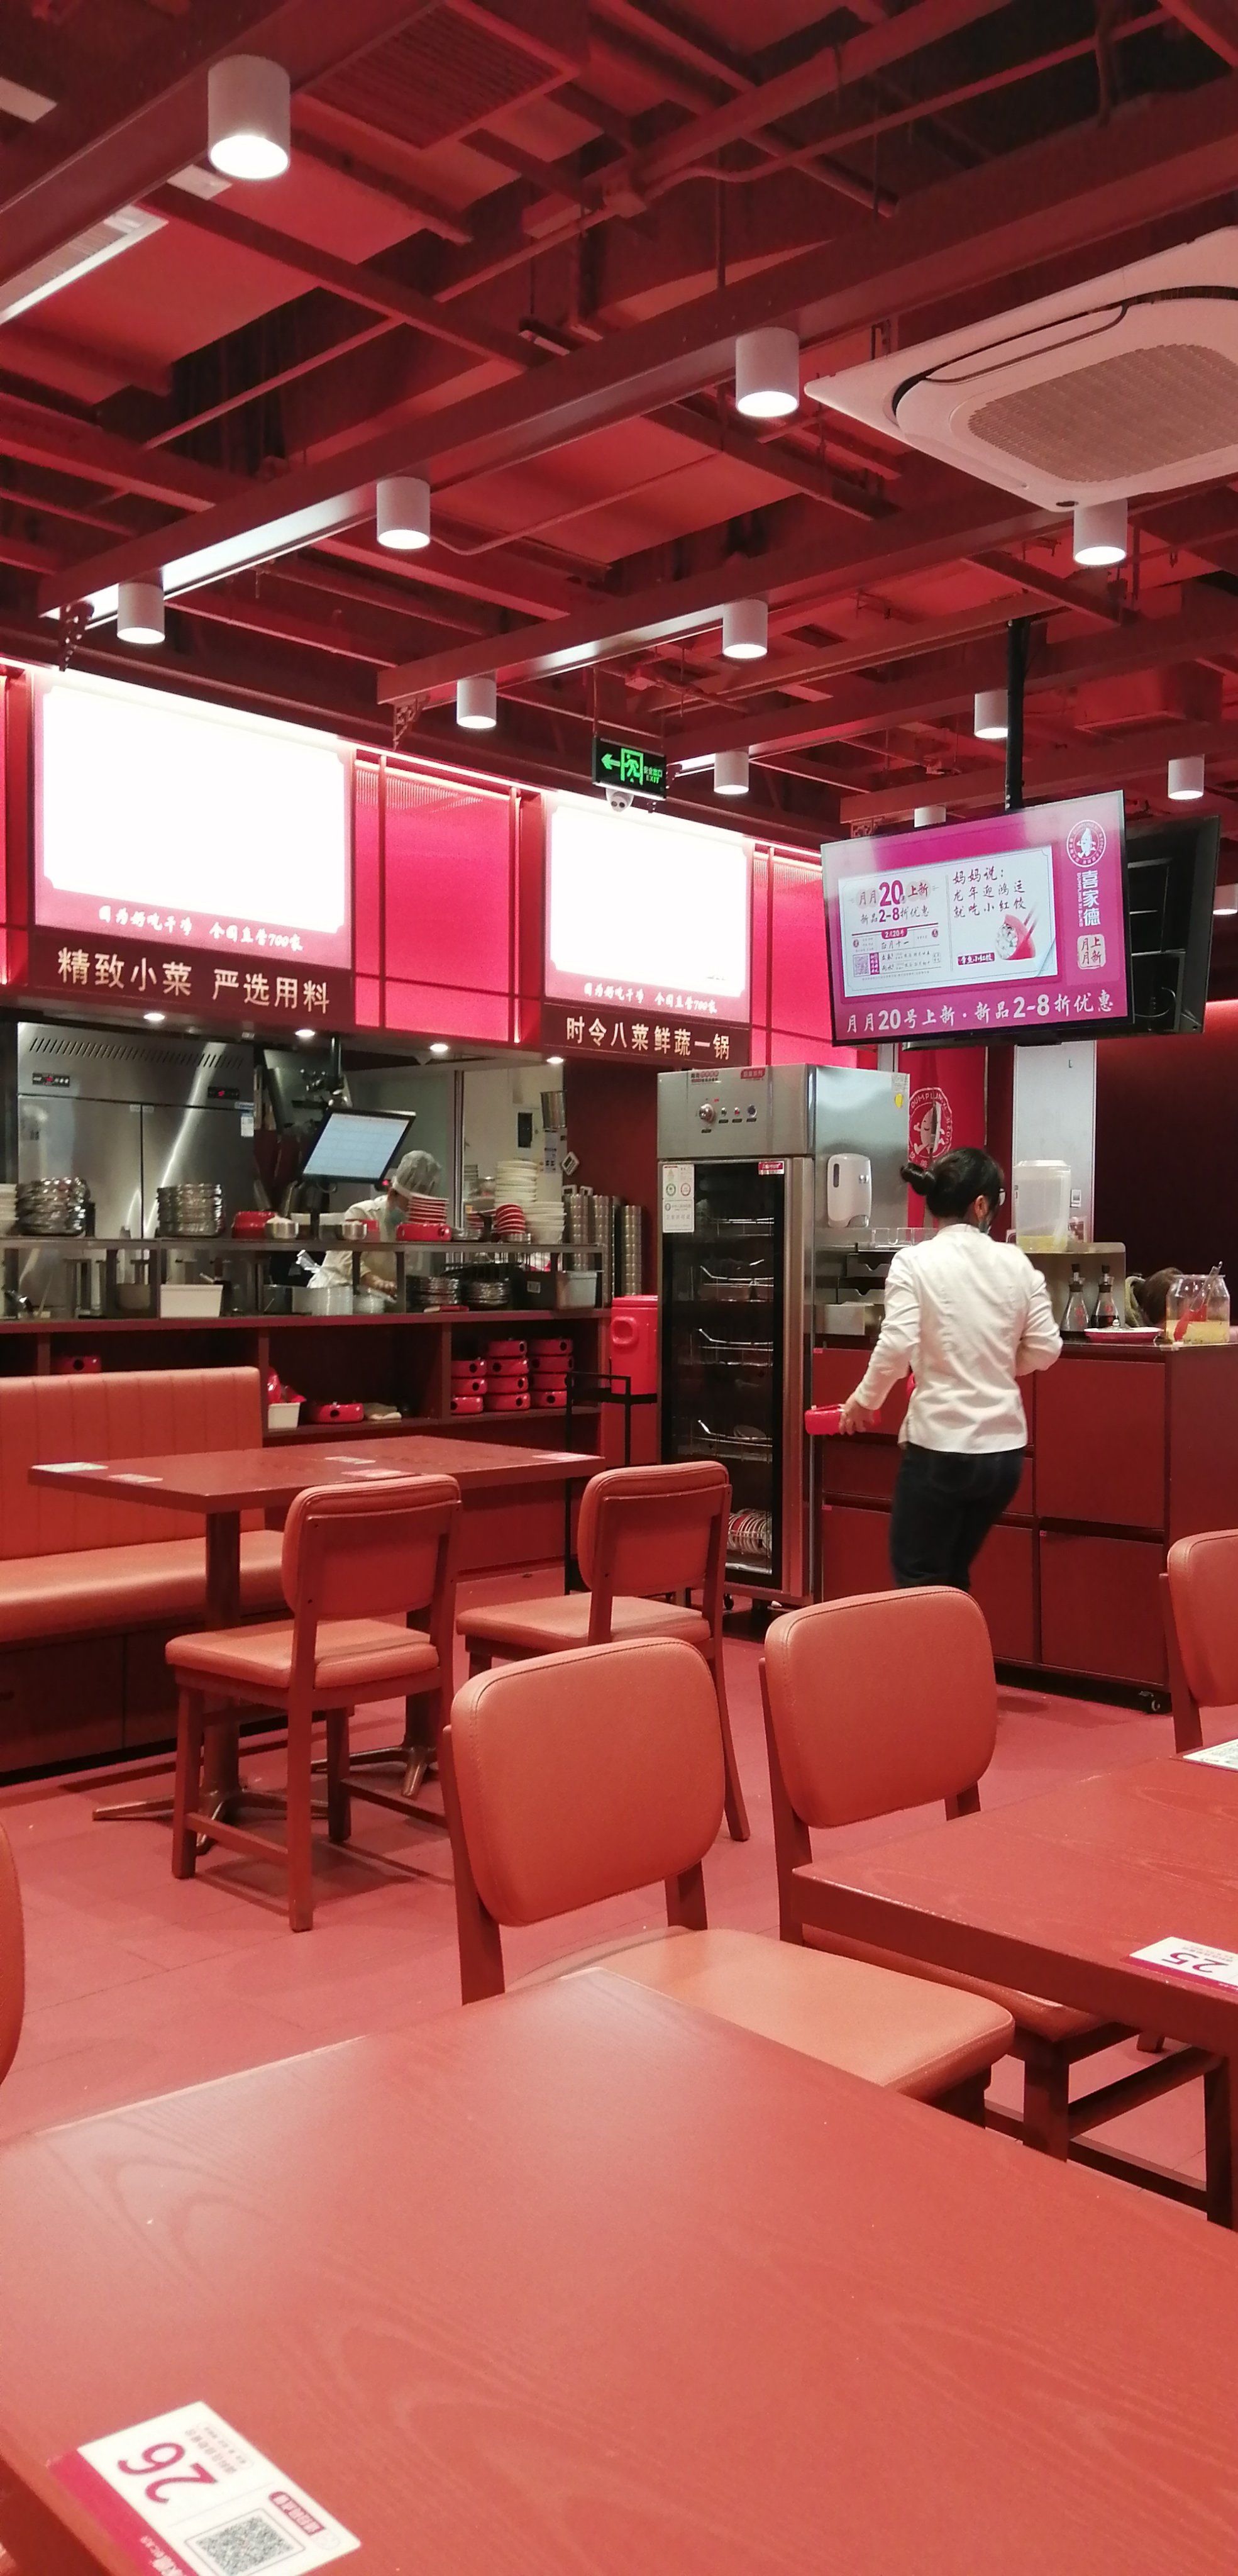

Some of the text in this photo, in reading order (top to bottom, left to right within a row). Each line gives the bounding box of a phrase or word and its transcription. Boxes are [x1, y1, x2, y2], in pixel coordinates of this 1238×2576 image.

[953, 880, 1025, 902] 龙年迎鸿运
[953, 897, 1026, 918] 就吃小红饺
[1081, 870, 1100, 926] 喜家德
[861, 906, 929, 924] 新品2-8折优惠
[58, 947, 331, 1014] 精致小菜 严选用料
[566, 1016, 730, 1060] 时令八菜鲜蔬一锅
[1162, 1951, 1229, 1974] 25
[118, 2443, 218, 2504] 26
